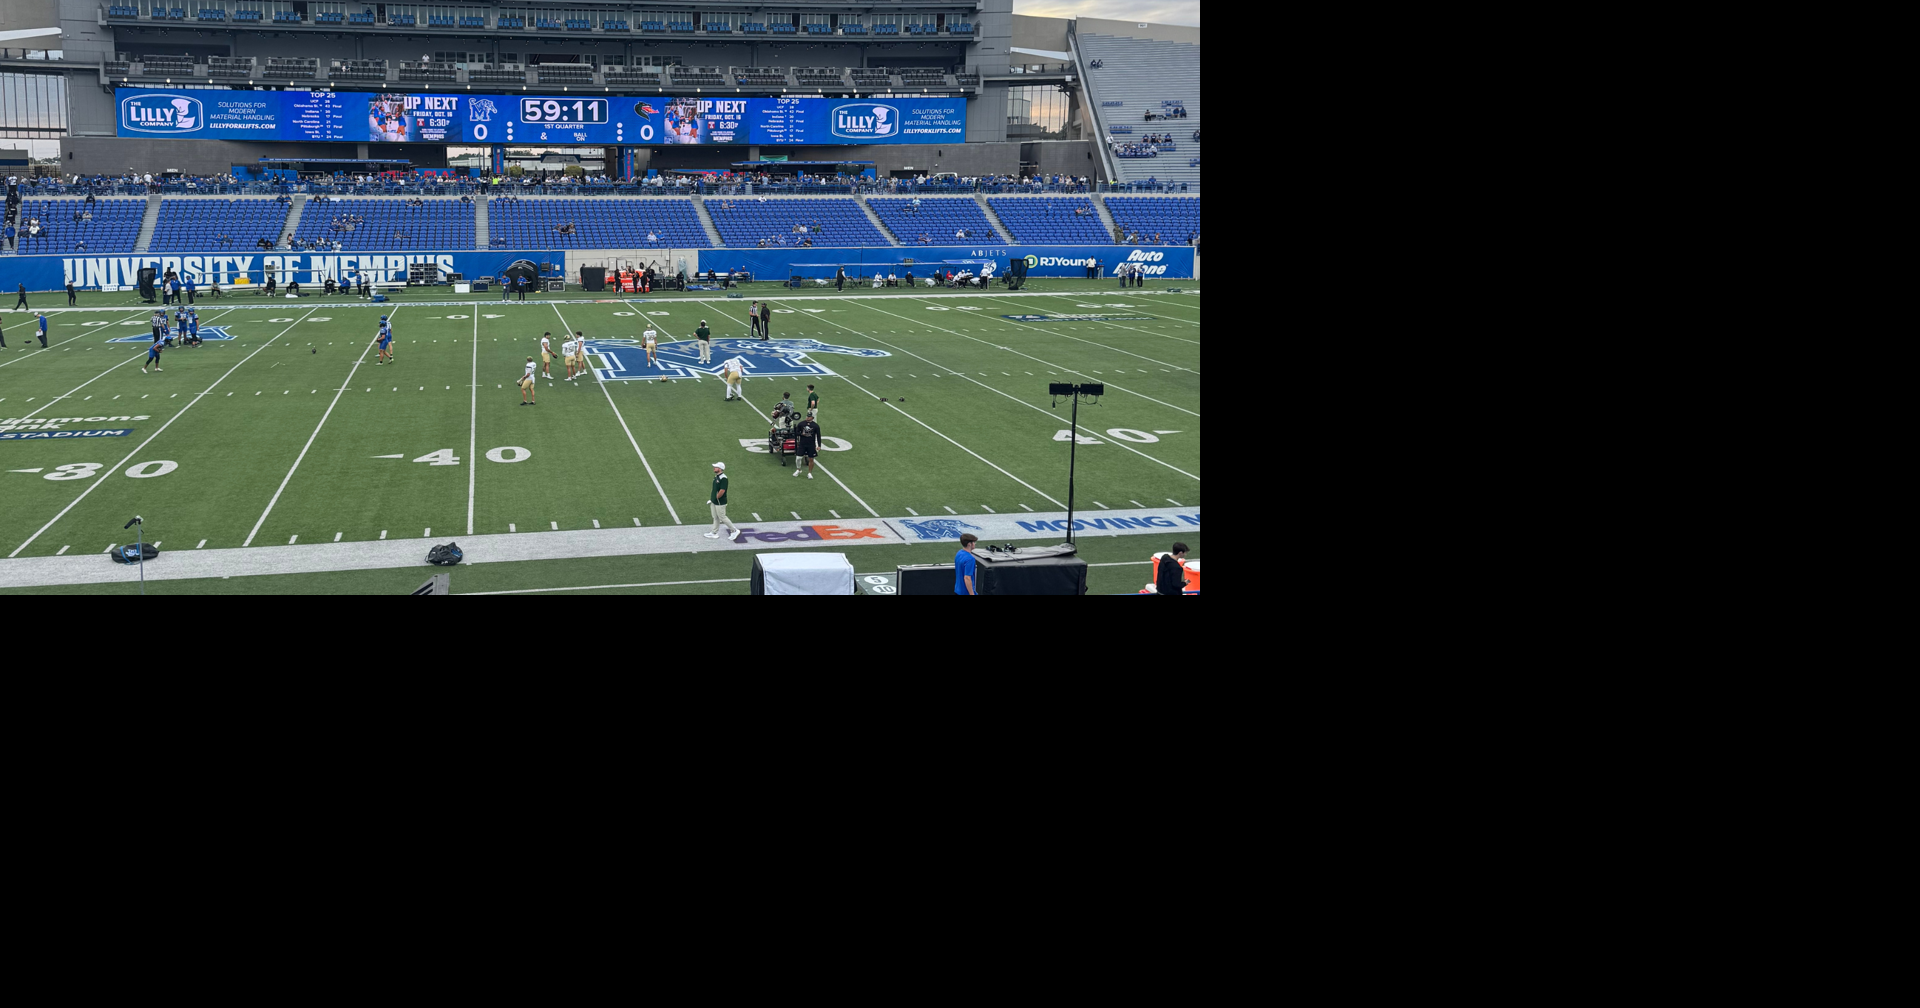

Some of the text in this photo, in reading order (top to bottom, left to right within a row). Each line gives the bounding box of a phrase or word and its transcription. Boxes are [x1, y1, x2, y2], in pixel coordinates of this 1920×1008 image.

[404, 96, 458, 110] UP NEXT
[697, 101, 747, 113] UP NEXT
[130, 106, 174, 121] LILLY
[525, 100, 599, 121] 59:11
[839, 115, 874, 128] LILLY
[474, 124, 488, 140] 0
[640, 125, 654, 140] 0
[1127, 250, 1164, 262] Auto
[263, 255, 301, 283] OF
[0, 415, 151, 424] immons
[0, 423, 65, 432] ank
[1, 430, 125, 439] STADIUM
[1016, 516, 1178, 532] MOVING
[726, 525, 885, 543] FedEx
